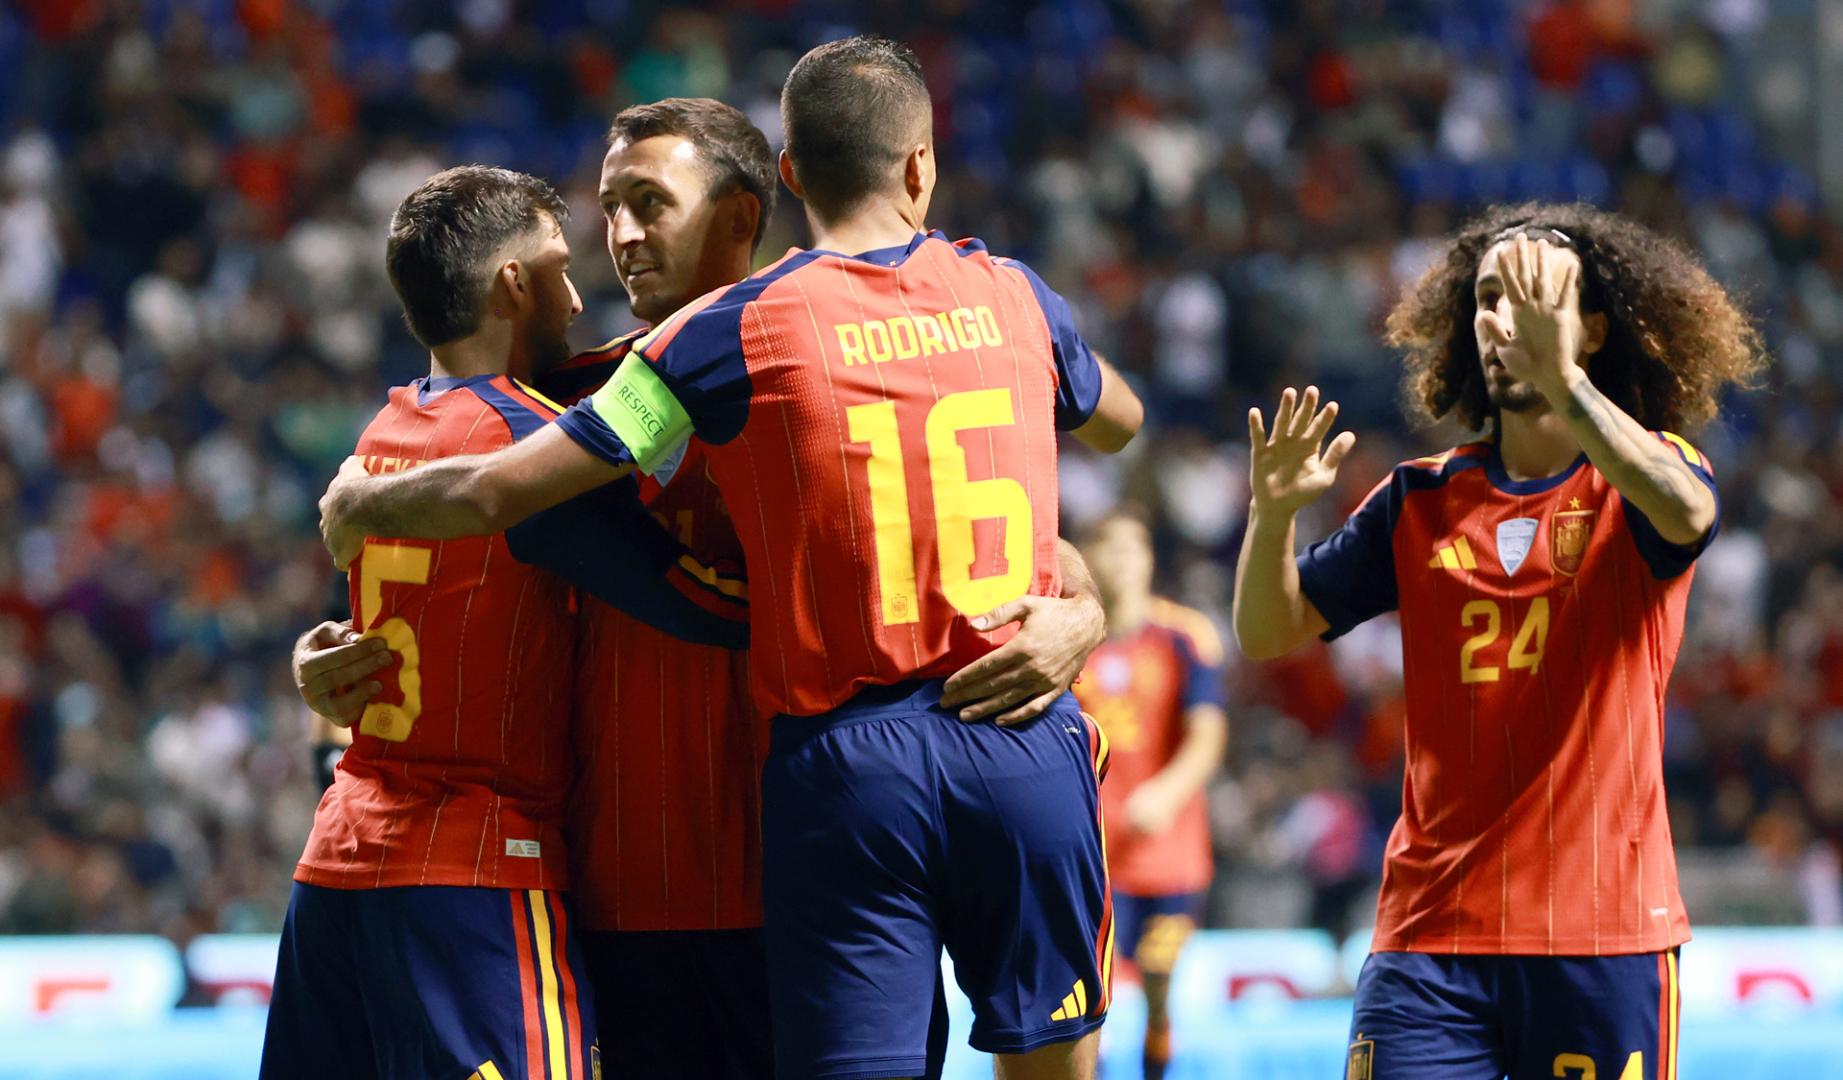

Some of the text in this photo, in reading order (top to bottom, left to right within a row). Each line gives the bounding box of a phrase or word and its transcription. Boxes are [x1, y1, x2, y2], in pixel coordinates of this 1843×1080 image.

[835, 305, 1003, 367] RODRIGO
[618, 385, 664, 437] RESPECT
[846, 387, 1033, 626] 16
[359, 544, 432, 742] 5
[1461, 596, 1550, 684] 24
